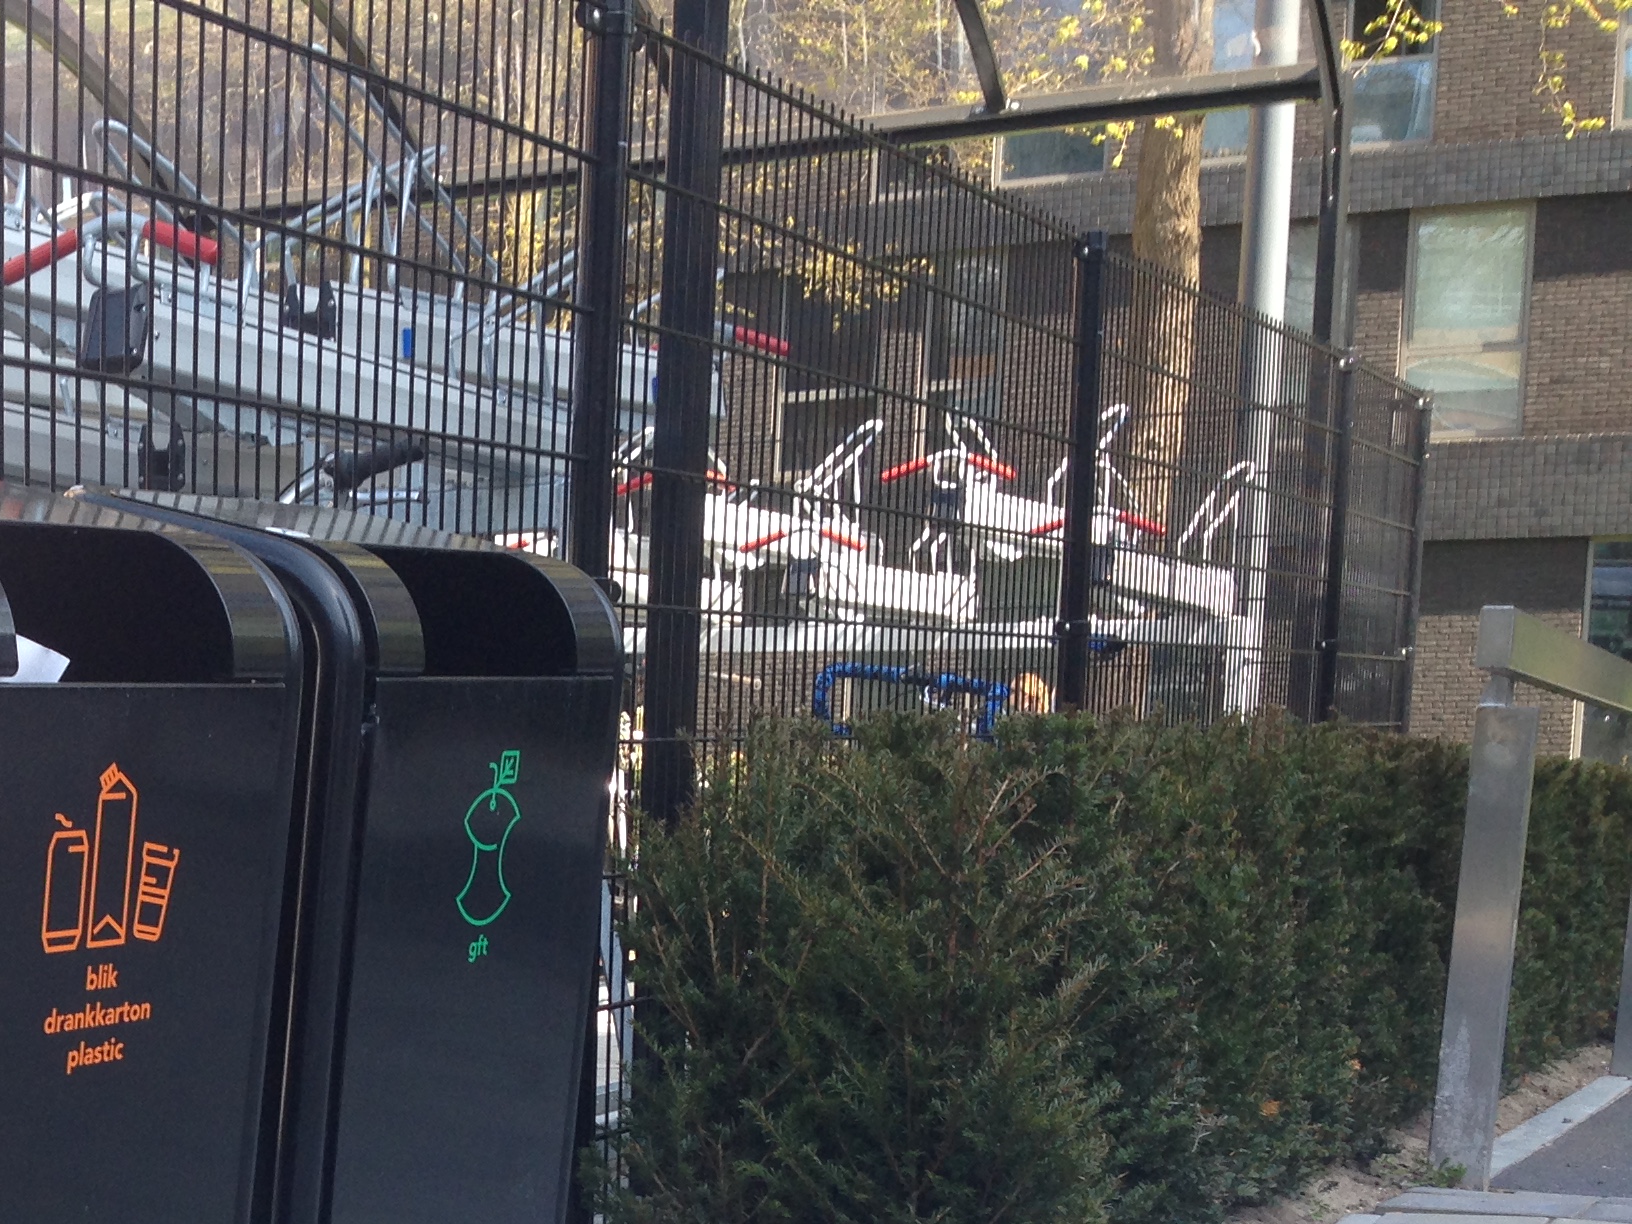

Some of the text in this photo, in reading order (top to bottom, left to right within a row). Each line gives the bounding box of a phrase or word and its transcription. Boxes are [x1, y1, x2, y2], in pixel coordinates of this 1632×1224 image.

[467, 934, 489, 963] gft
[85, 964, 118, 991] blik
[43, 1002, 151, 1034] drankkarton
[66, 1037, 124, 1075] plastic
